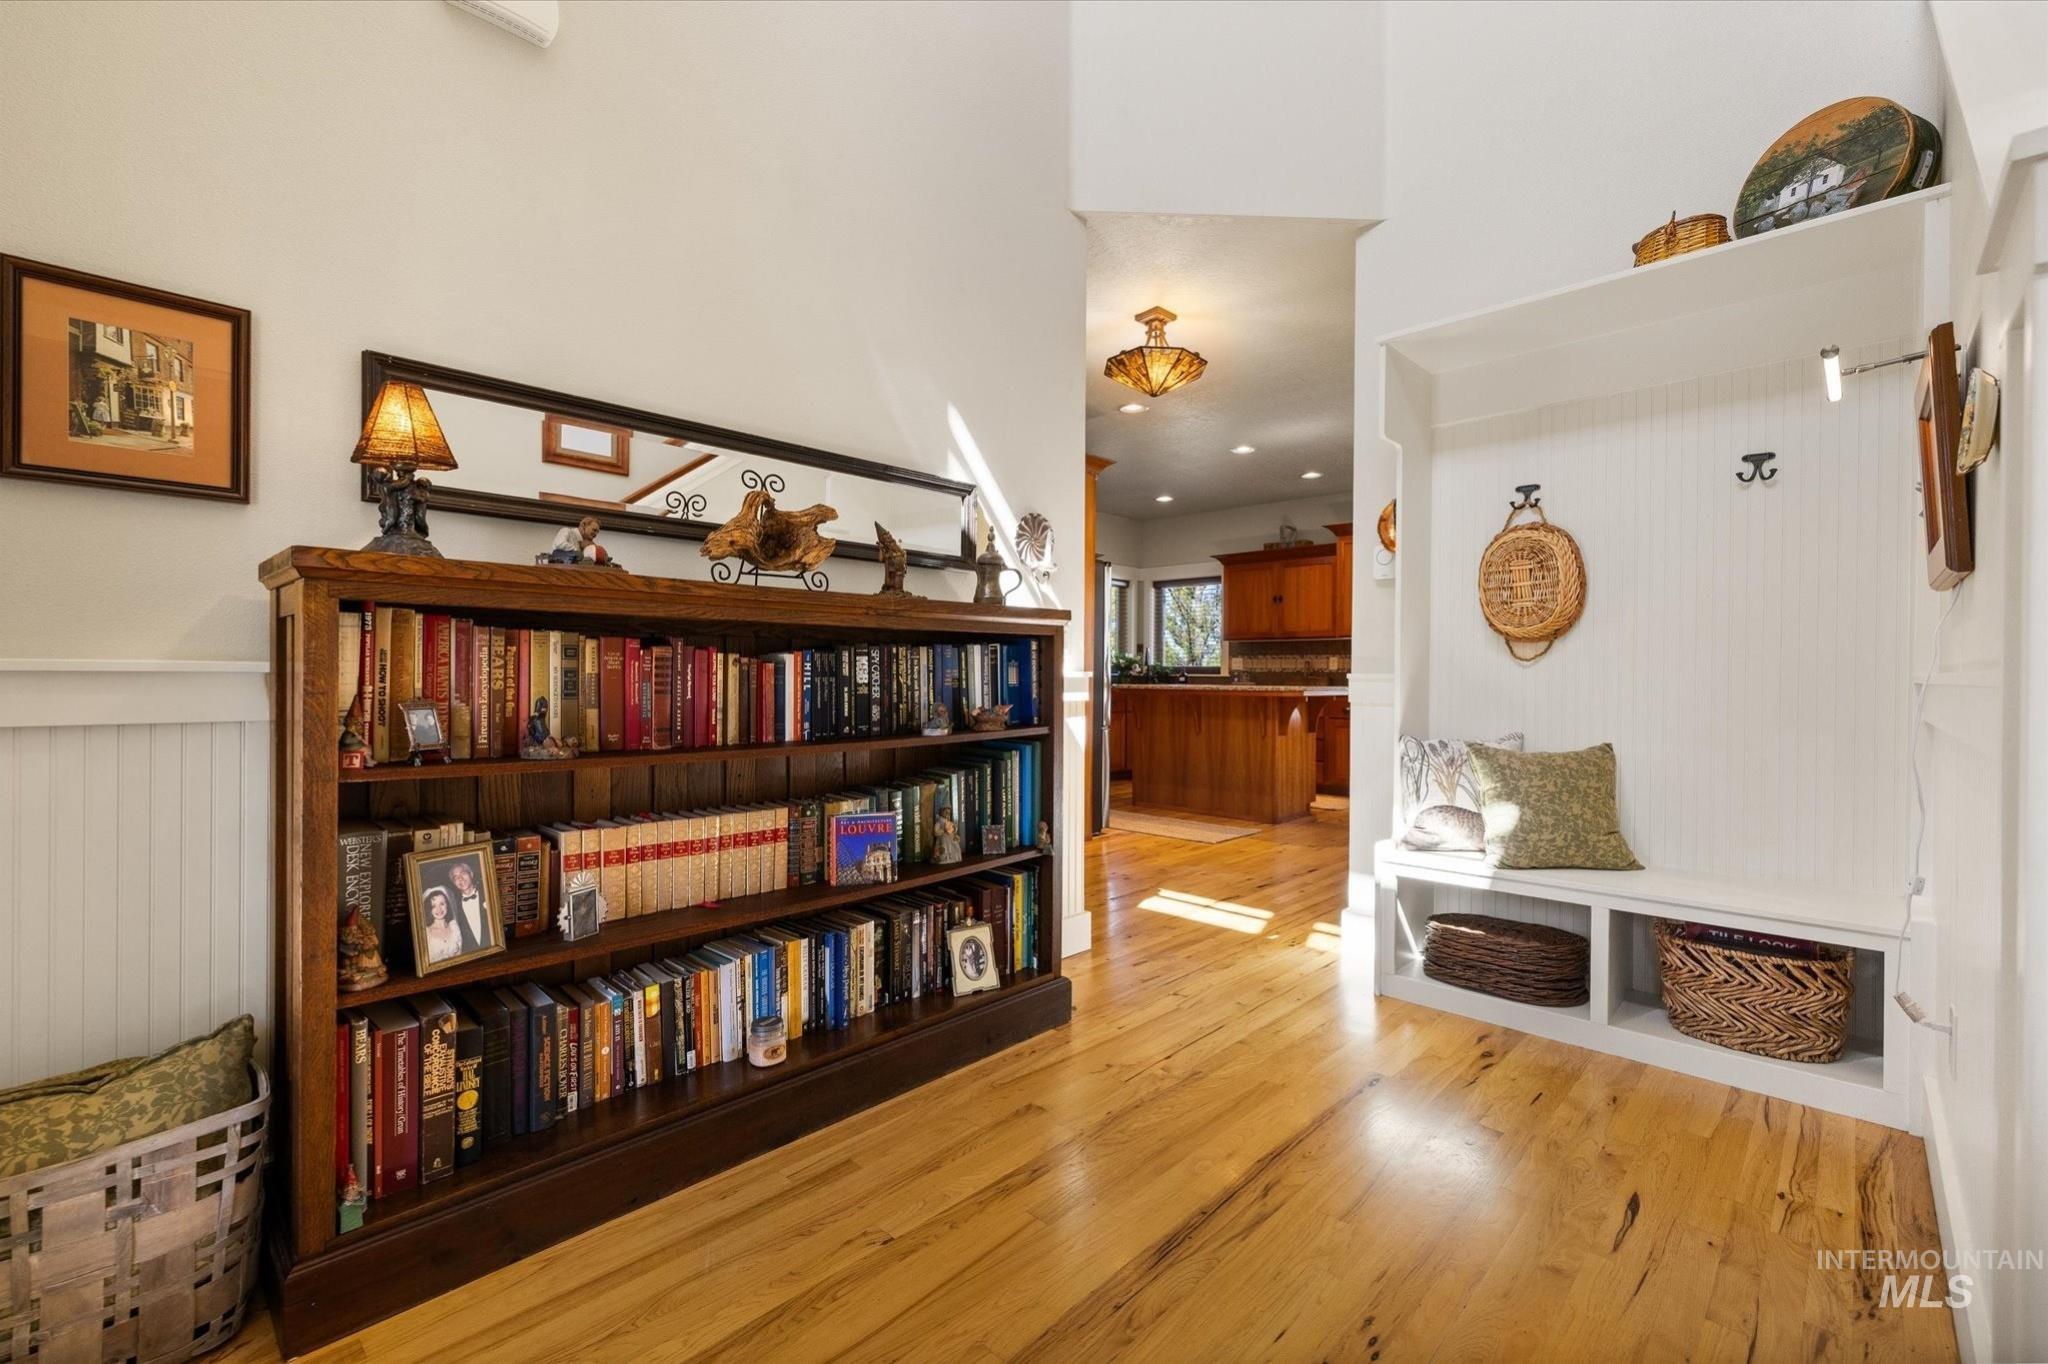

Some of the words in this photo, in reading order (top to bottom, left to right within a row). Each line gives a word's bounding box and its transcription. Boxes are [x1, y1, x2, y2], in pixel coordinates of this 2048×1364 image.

[438, 622, 449, 663] AMERICA
[492, 635, 504, 690] BEARS
[505, 646, 516, 677] Pageant
[871, 649, 880, 665] SPY
[437, 666, 449, 698] WANTS
[479, 647, 489, 704] Encyclopedia
[507, 678, 515, 686] of
[871, 665, 880, 699] CATCHER
[379, 685, 386, 697] TO
[506, 688, 515, 700] the
[378, 698, 386, 727] SHOOT
[478, 705, 488, 743] Firearms
[345, 753, 359, 768] T
[340, 835, 383, 846] WEBSTER'S
[840, 824, 893, 835] LOUVRE
[346, 845, 359, 872] DESK
[360, 844, 372, 867] NEW
[355, 1029, 367, 1064] BEARS
[398, 1031, 406, 1045] The
[424, 1044, 432, 1055] OF
[559, 1028, 567, 1069] CHARLES
[397, 1047, 406, 1081] Timetables
[431, 1029, 440, 1094] CONCORDANCE
[570, 1042, 578, 1062] LOU'S
[424, 1058, 432, 1073] THE
[438, 1043, 446, 1091] EXHAUSTIVE
[446, 1049, 455, 1089] STRONG'S
[570, 1063, 576, 1071] ON
[397, 1082, 406, 1090] of
[424, 1074, 432, 1096] BIBLE
[559, 1070, 567, 1099] BOYER
[569, 1072, 577, 1091] FIRST
